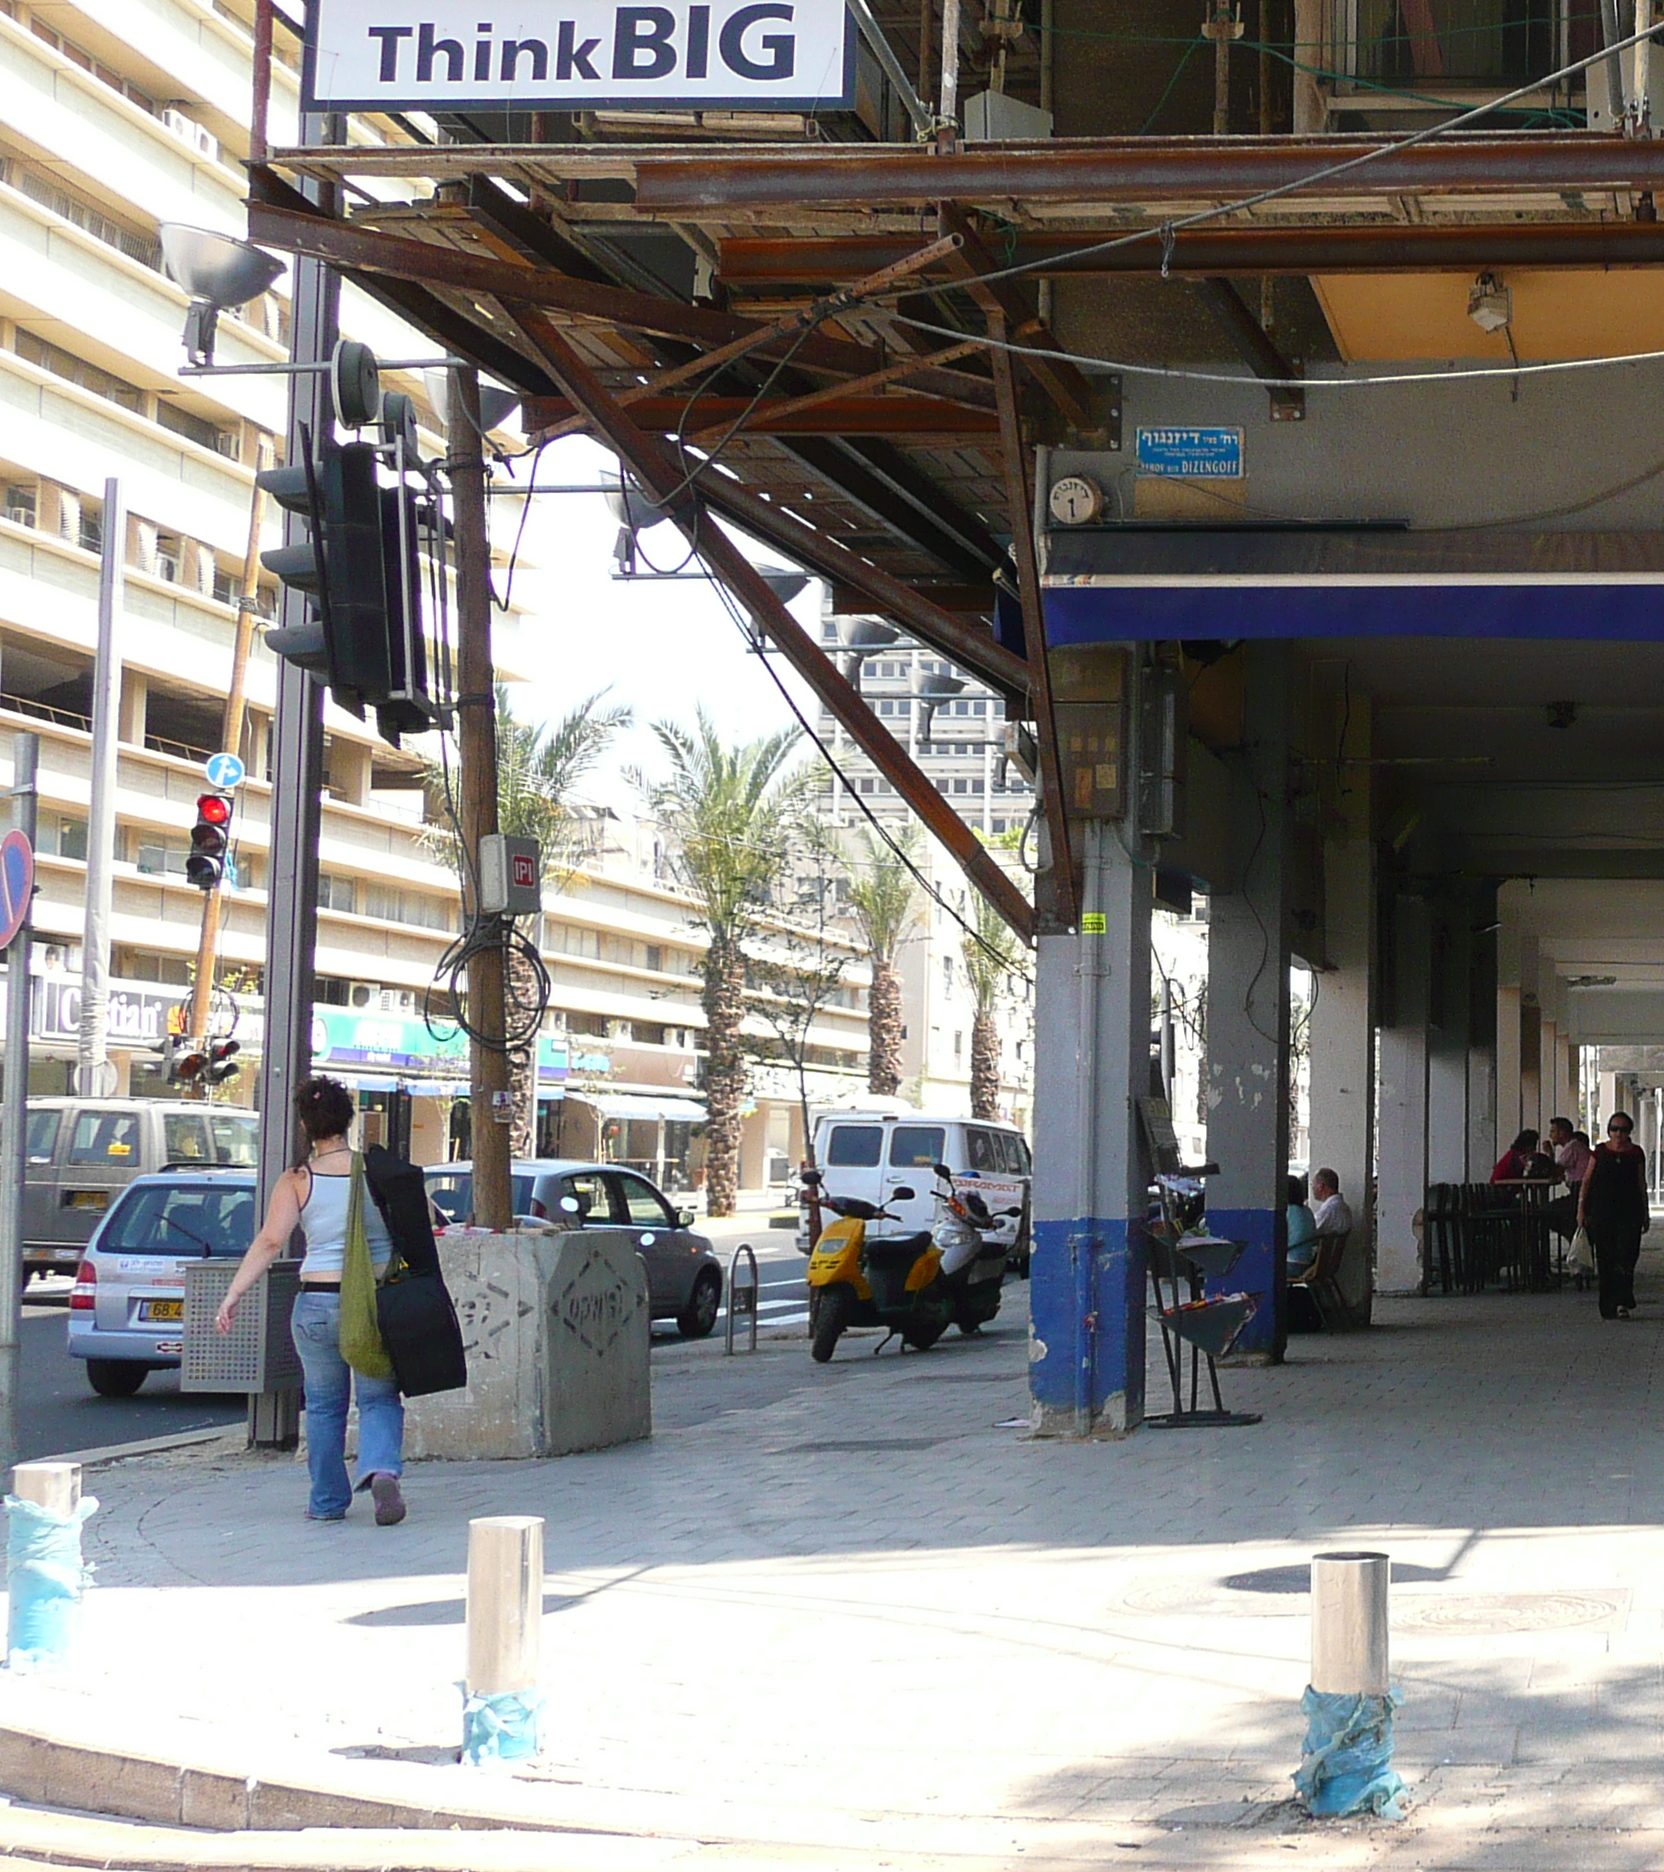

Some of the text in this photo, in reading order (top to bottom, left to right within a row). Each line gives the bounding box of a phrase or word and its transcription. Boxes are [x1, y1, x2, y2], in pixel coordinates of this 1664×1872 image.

[368, 3, 796, 82] ThinkBIG
[1142, 431, 1200, 447] דיזנגוף
[1182, 460, 1237, 473] DIZENGOFF
[1067, 498, 1075, 518] 1
